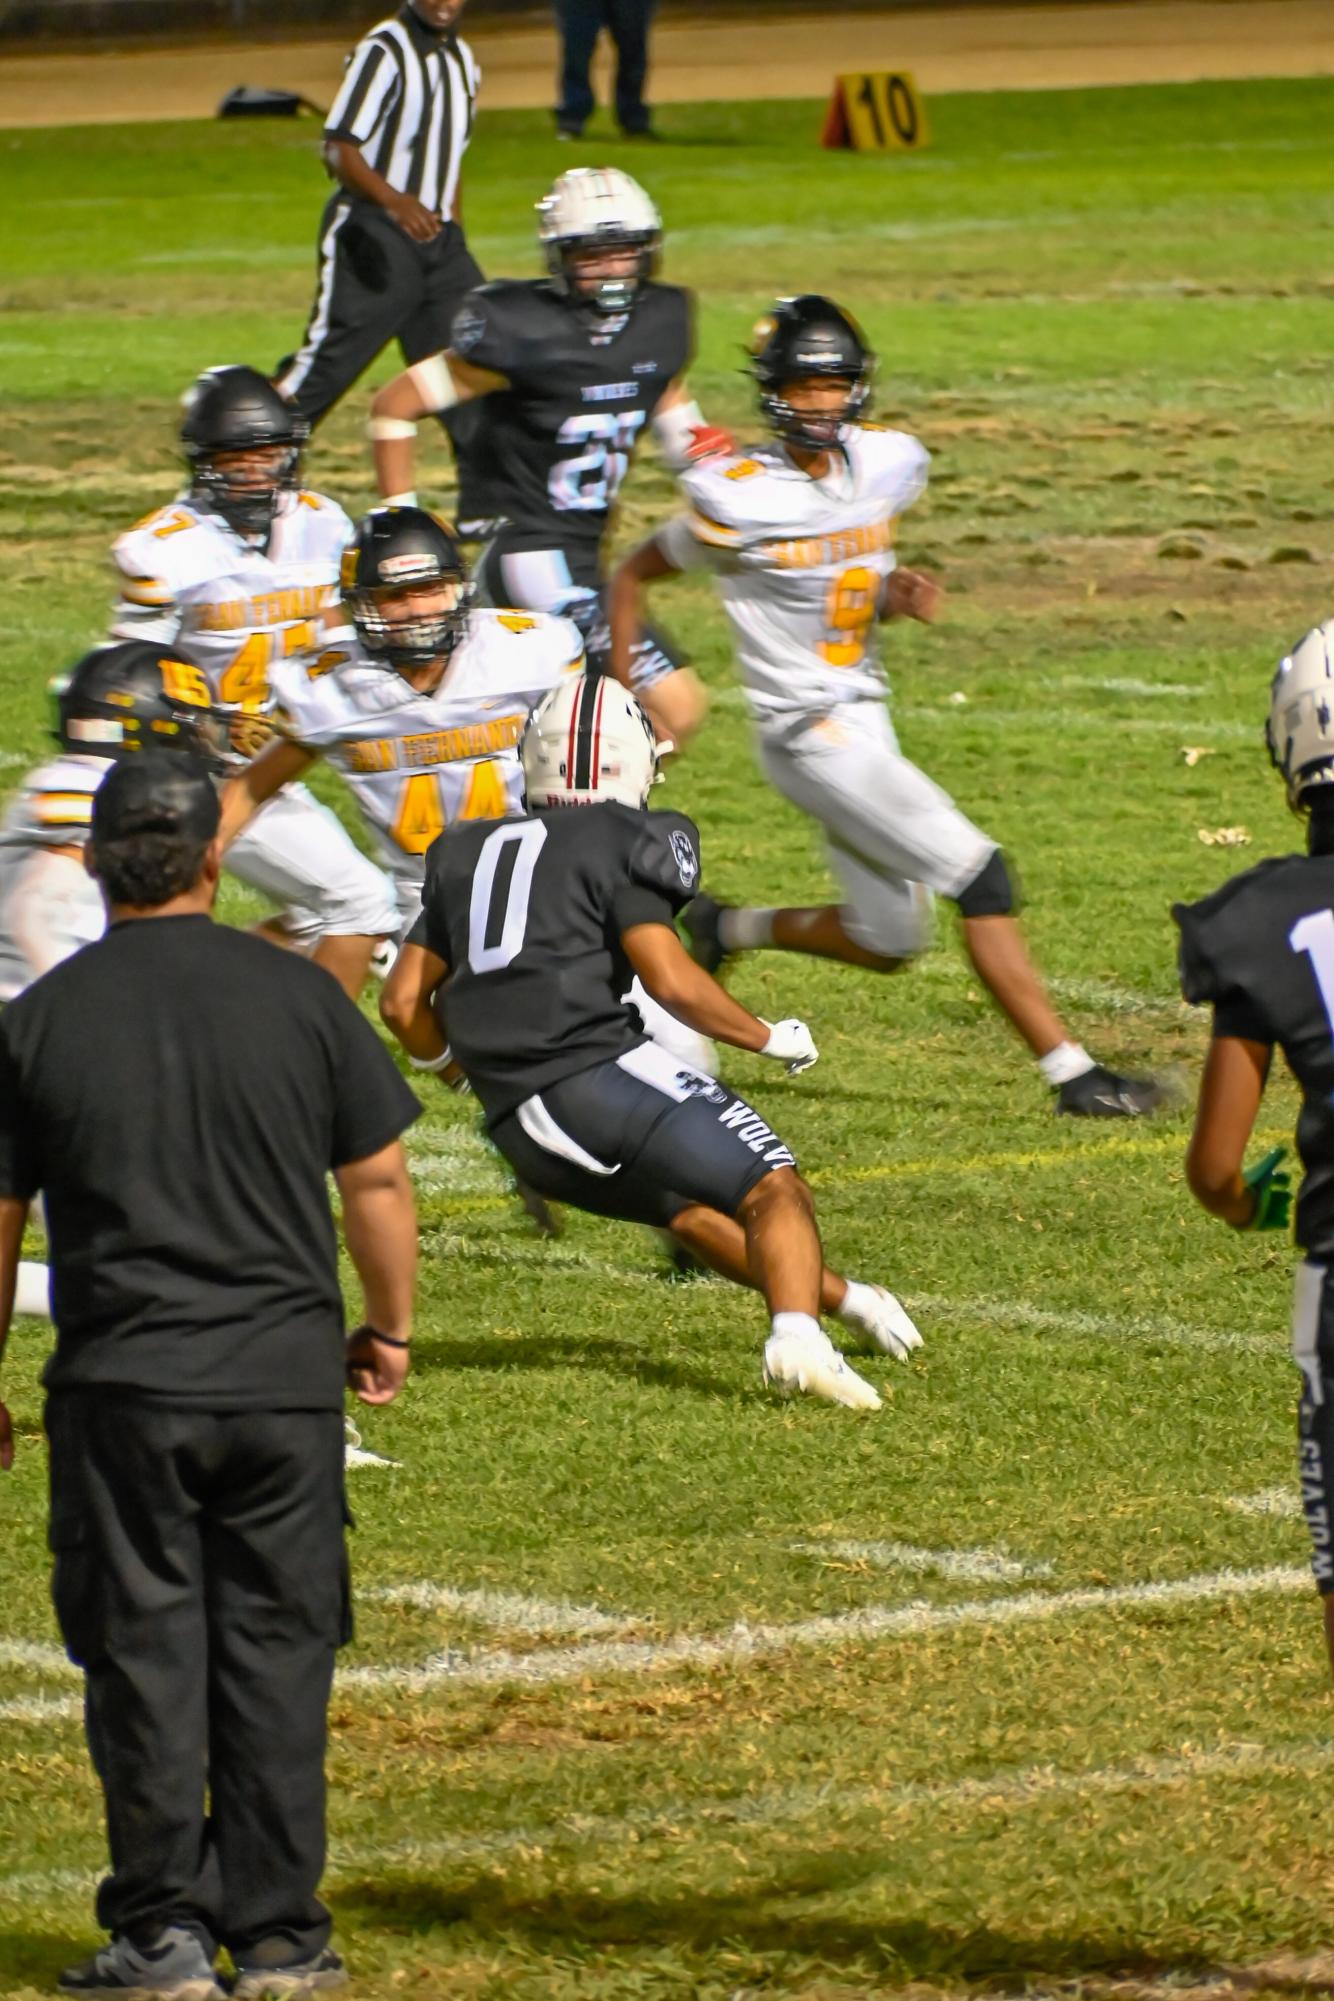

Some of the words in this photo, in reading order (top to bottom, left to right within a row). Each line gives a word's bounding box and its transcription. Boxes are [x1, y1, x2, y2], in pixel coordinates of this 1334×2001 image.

[858, 76, 917, 146] 10
[820, 567, 880, 667] 9
[402, 713, 525, 766] FERNAND
[468, 818, 548, 975] 0
[1302, 1438, 1333, 1581] WOLVES
